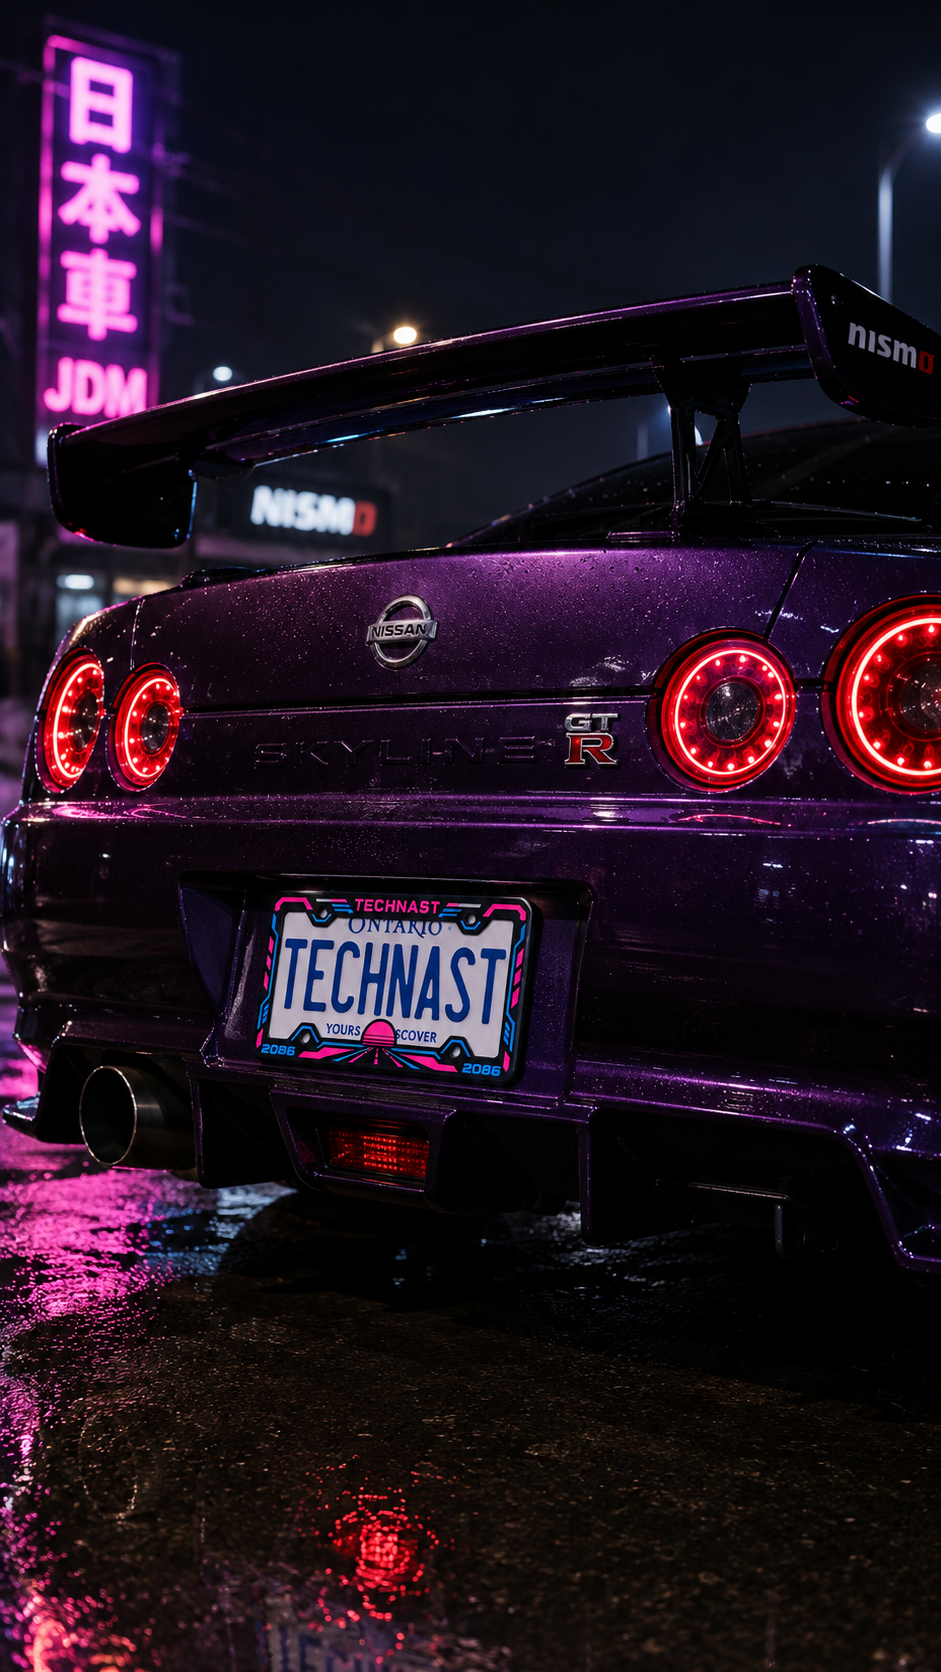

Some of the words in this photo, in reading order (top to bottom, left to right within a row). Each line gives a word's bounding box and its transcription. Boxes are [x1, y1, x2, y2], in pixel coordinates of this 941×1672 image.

[58, 56, 141, 340] 日本車
[848, 321, 934, 375] nismo
[43, 356, 148, 419] JDM
[371, 624, 427, 638] NISSAN
[565, 713, 618, 732] GT
[254, 736, 536, 768] SKYLINE
[564, 732, 618, 765] R
[355, 898, 440, 914] TECHNAST
[348, 918, 442, 938] ONTARIO
[284, 938, 506, 1025] TECHNAST
[326, 1023, 360, 1036] YOURS
[261, 1044, 296, 1056] 2086
[462, 1063, 501, 1077] 2086
